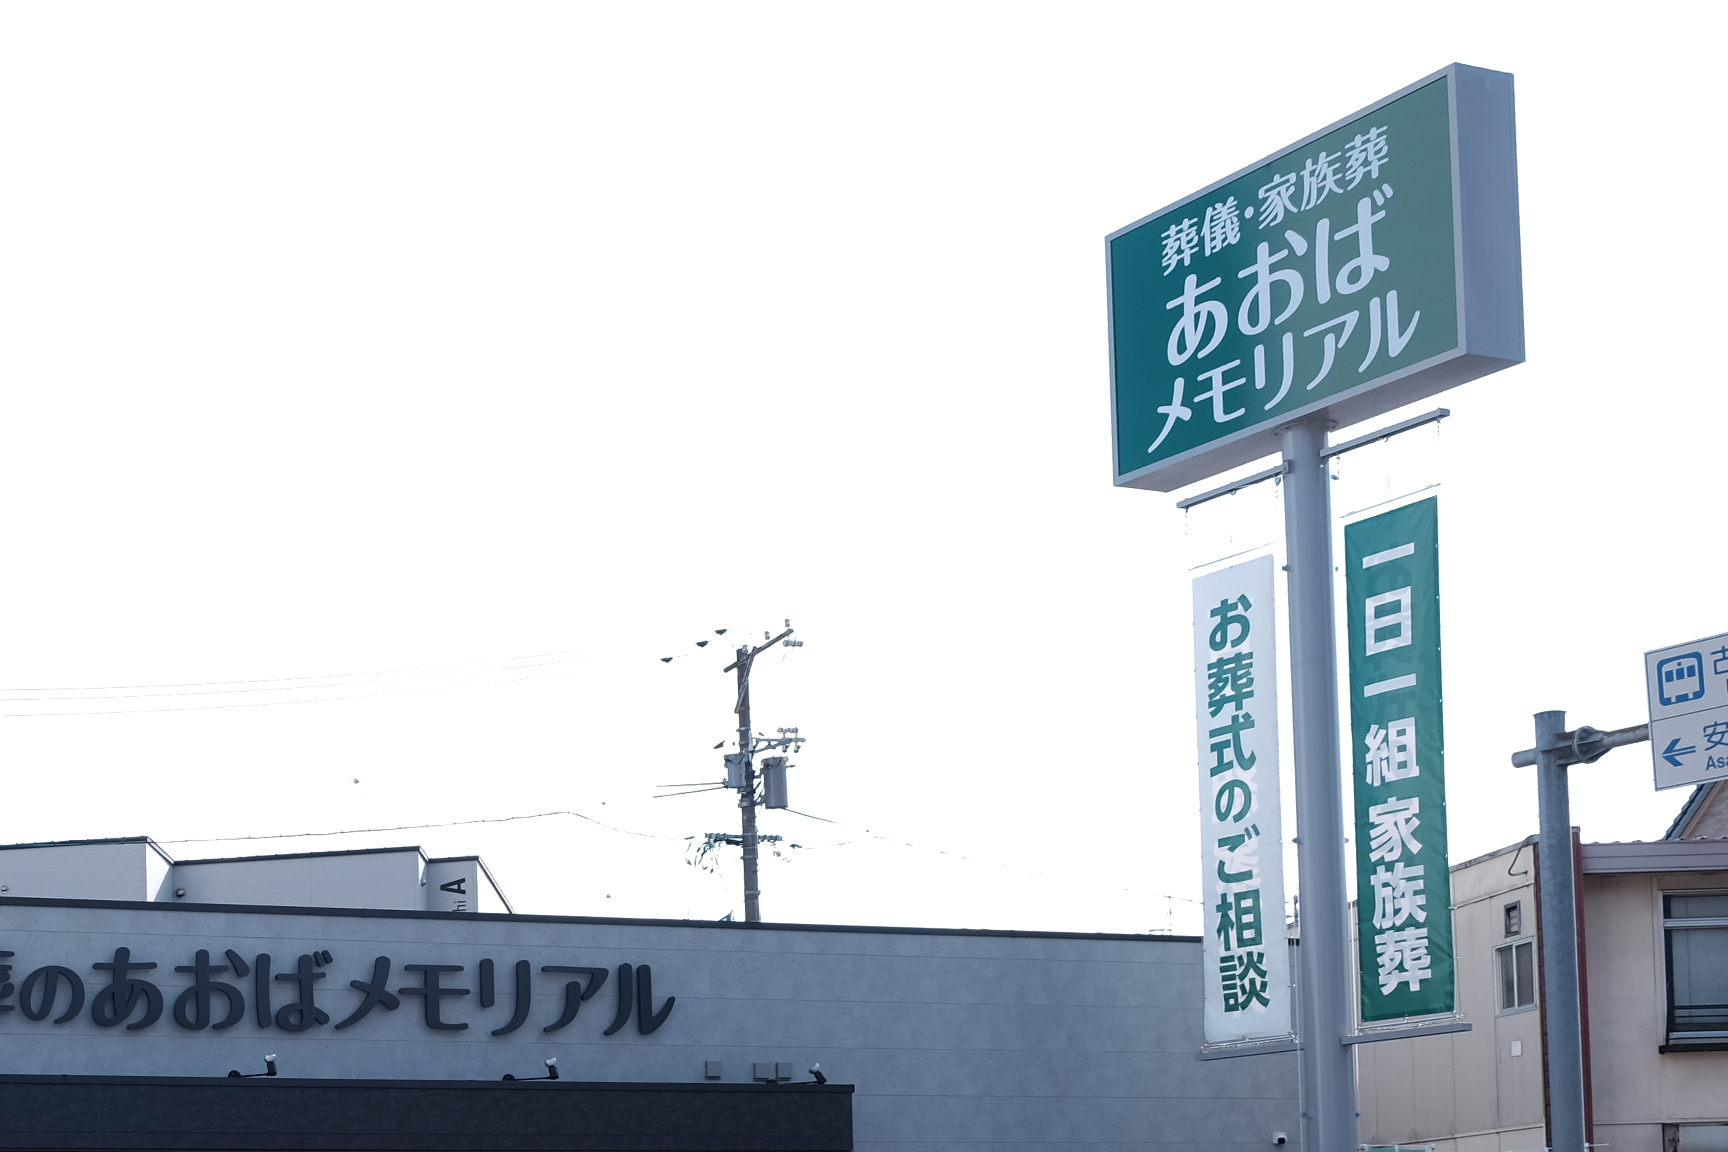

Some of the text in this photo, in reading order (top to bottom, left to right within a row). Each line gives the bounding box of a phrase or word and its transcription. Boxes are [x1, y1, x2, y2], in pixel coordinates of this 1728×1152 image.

[1161, 126, 1389, 276] 葬儀・家族葬
[1166, 183, 1393, 366] あおば
[1148, 290, 1421, 453] メモリアル
[1207, 593, 1270, 1013] お葬式のご相談
[1362, 541, 1433, 996] 一日一組家族葬
